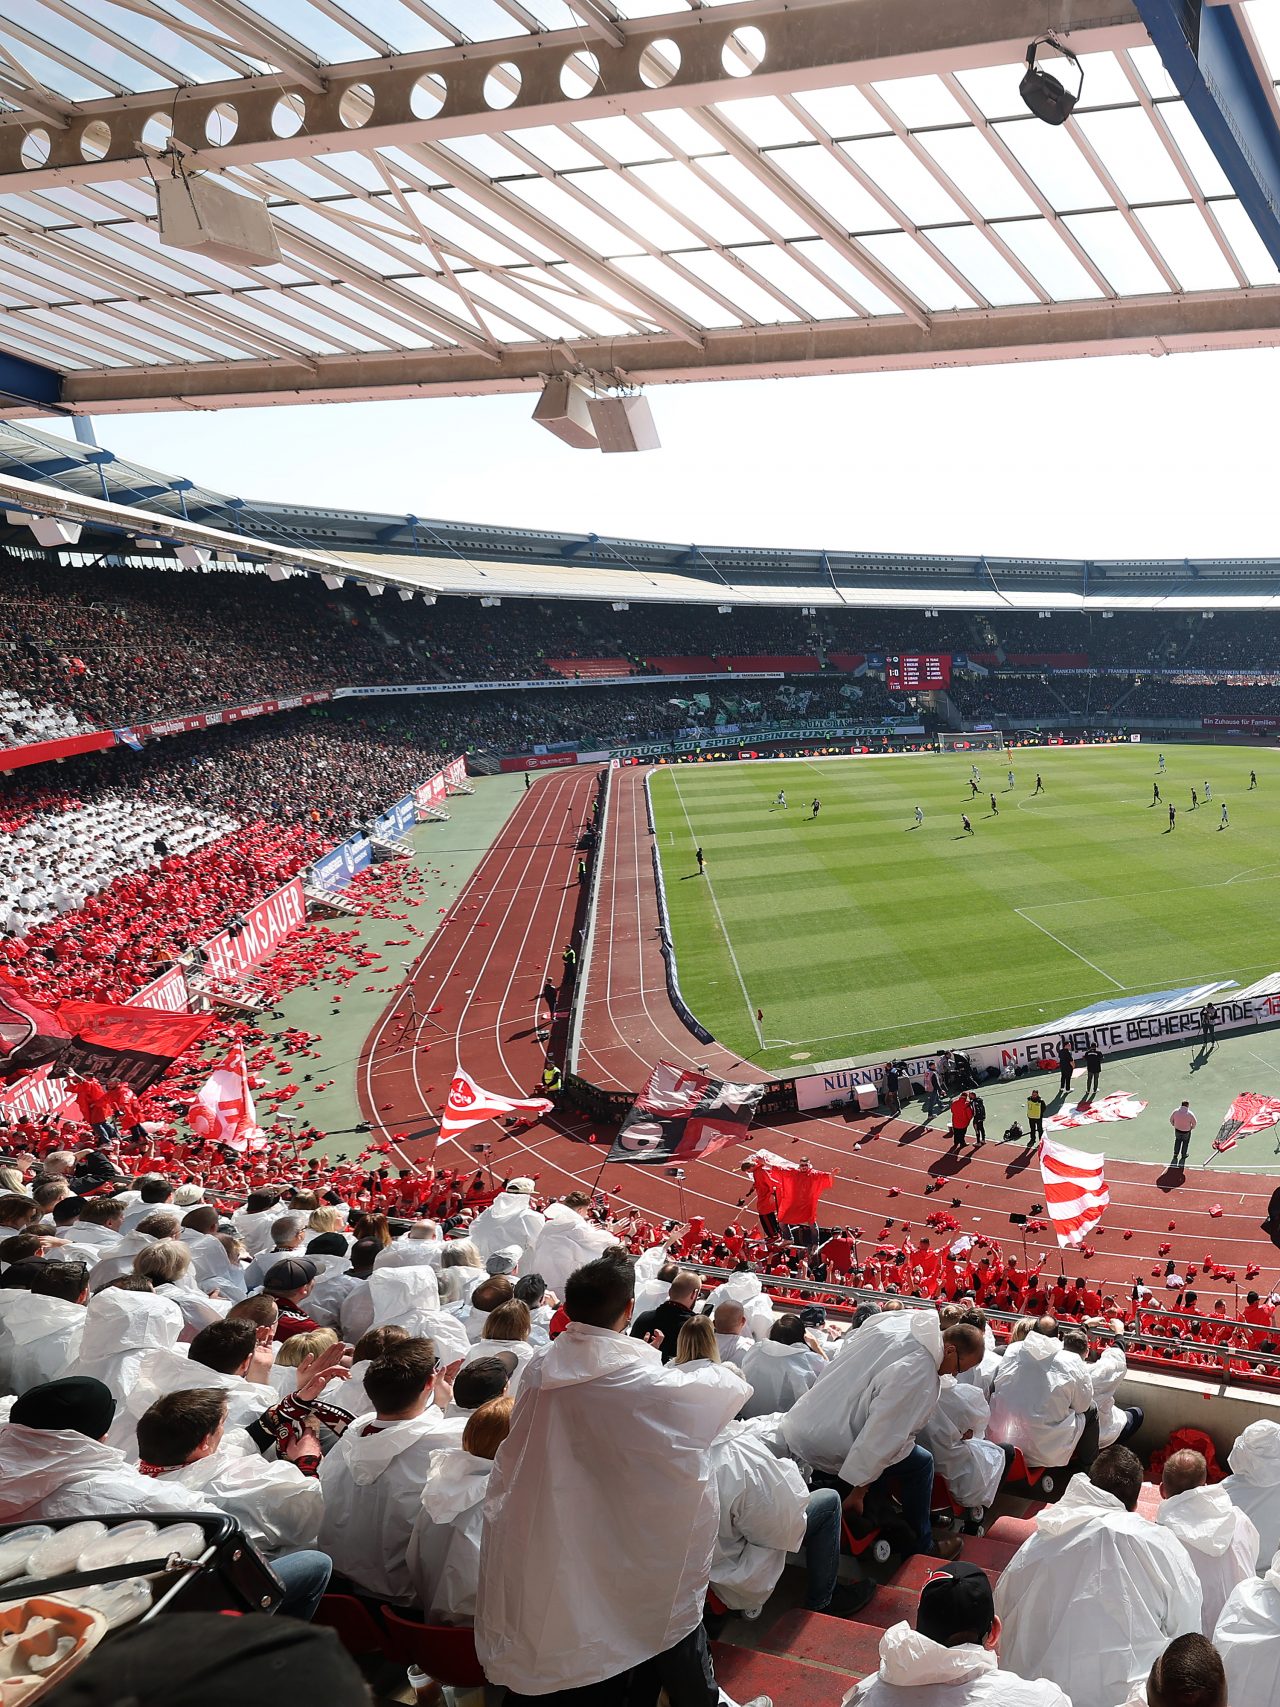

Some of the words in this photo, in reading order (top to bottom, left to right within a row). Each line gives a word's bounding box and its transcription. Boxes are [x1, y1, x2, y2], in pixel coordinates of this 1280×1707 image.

[1214, 718, 1240, 726] Zuhause
[1241, 718, 1250, 726] für
[608, 744, 671, 759] ZURÜCK
[674, 741, 701, 752] ZUR
[705, 730, 836, 749] SPIELVEREINIGUNG
[1060, 1025, 1122, 1051] HEUTE
[823, 1058, 936, 1091] NÜRNBGE
